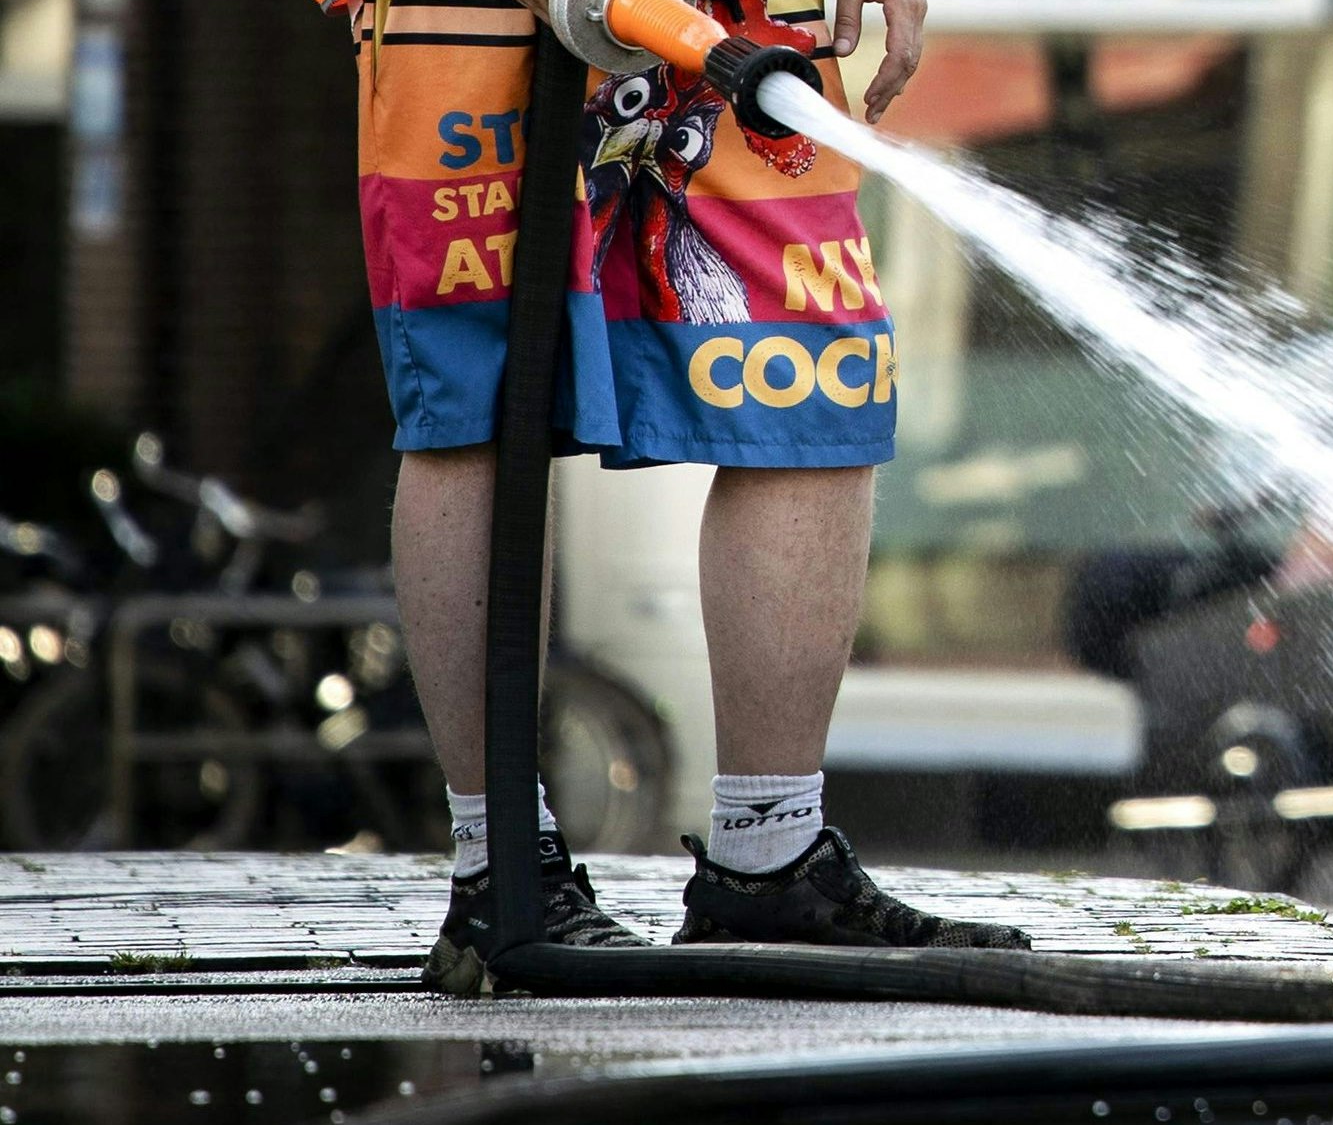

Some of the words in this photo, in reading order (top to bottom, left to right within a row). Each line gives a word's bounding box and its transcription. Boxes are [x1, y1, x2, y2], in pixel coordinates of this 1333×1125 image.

[438, 108, 529, 170] ST
[783, 237, 883, 312] MY
[723, 807, 812, 831] LOTTO
